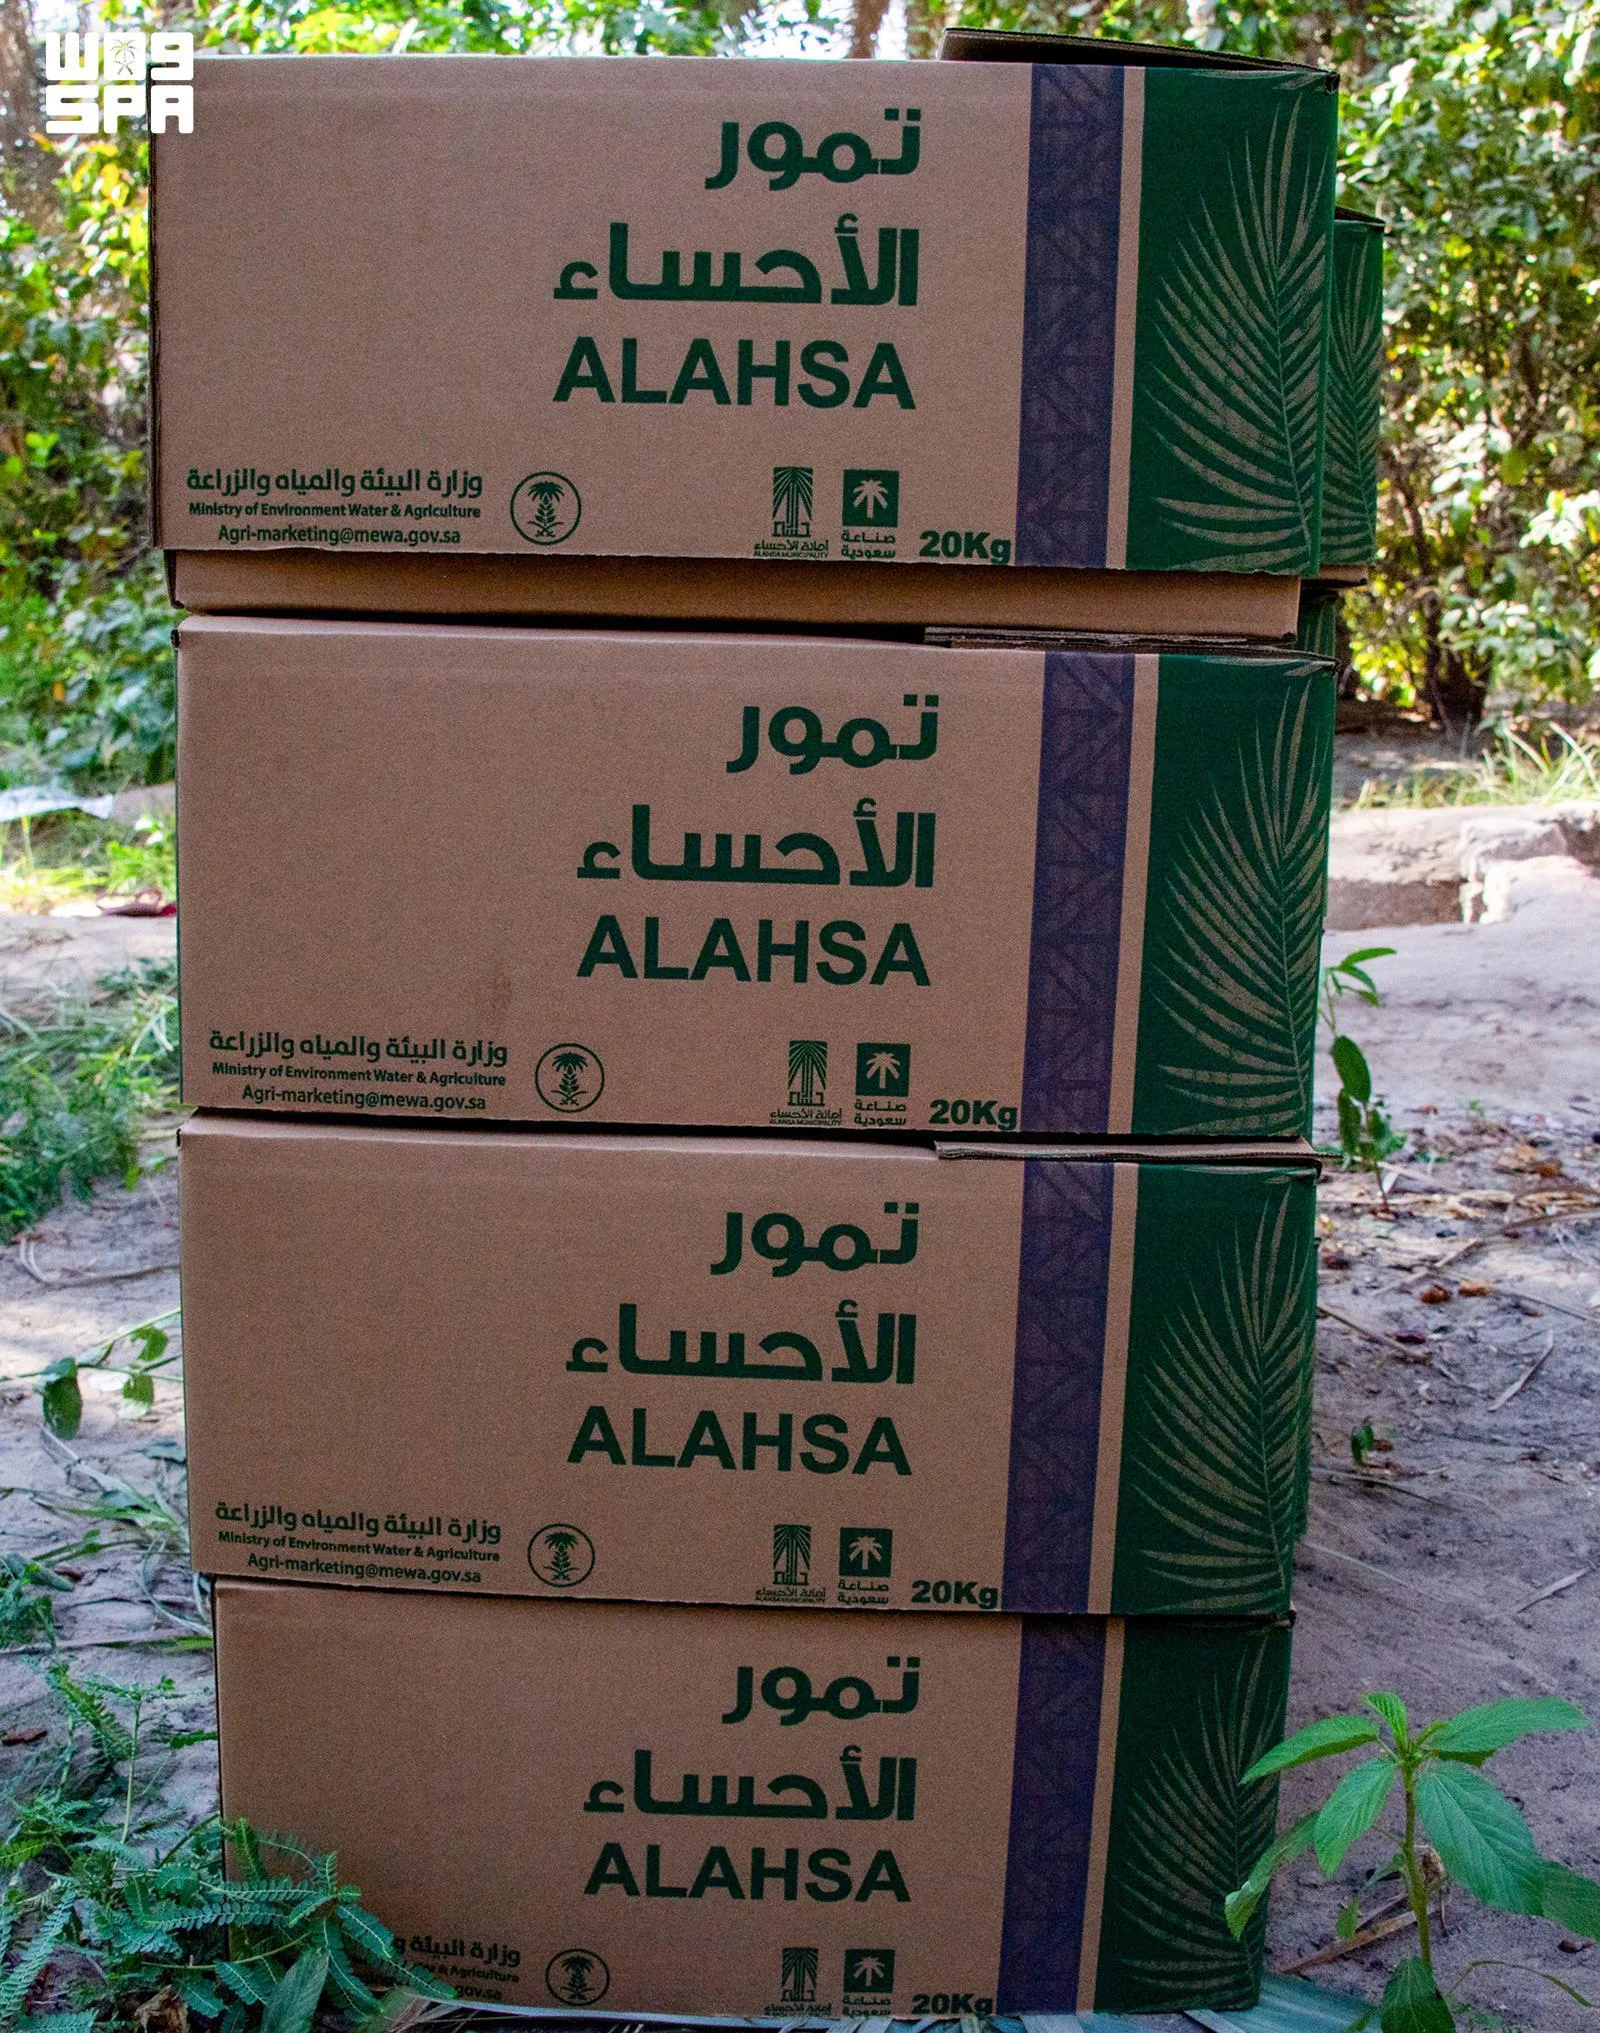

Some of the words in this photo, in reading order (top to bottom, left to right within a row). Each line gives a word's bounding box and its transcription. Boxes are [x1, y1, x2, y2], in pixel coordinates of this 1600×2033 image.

[704, 108, 921, 191] تمور
[553, 213, 920, 306] الأحساء
[552, 336, 916, 409] ALAHSA
[187, 468, 270, 498] والزراعة
[275, 468, 355, 498] والمياه
[360, 467, 421, 497] البيئة
[427, 469, 484, 499] وزارة
[189, 502, 242, 519] Ministry
[245, 502, 259, 515] of
[261, 503, 347, 516] Environment
[349, 503, 388, 517] Water
[391, 504, 401, 516] &
[404, 504, 481, 520] Agriculture
[218, 524, 461, 546] Agri-marketing@mewa.gov.sa
[841, 530, 896, 544] صناعة
[919, 530, 1011, 565] 20Kg
[841, 544, 896, 559] سعودية
[726, 694, 939, 775] تمور
[577, 797, 936, 888] الأحساء
[576, 914, 931, 986] ALAHSA
[209, 1030, 295, 1059] والزراعة
[300, 1034, 381, 1063] والمياه
[386, 1036, 446, 1063] البيئة
[452, 1039, 507, 1067] وزارة
[212, 1062, 266, 1079] Ministry
[269, 1065, 283, 1077] of
[286, 1066, 371, 1080] Environment
[373, 1069, 413, 1083] Water
[416, 1072, 427, 1083] &
[429, 1072, 506, 1087] Agriculture
[242, 1084, 486, 1112] Agri-marketing@mewa.gov.sa
[854, 1099, 906, 1112] صناعة
[854, 1114, 906, 1127] سعودية
[929, 1099, 1017, 1130] 20Kg
[710, 1202, 920, 1277] تمور
[566, 1299, 916, 1384] الأحساء
[567, 1405, 912, 1476] ALAHSA
[215, 1502, 297, 1531] والزراعة
[302, 1509, 379, 1537] والمياه
[384, 1513, 442, 1539] البيئة
[448, 1518, 501, 1544] وزارة
[219, 1531, 269, 1548] Ministry
[273, 1536, 286, 1546] of
[289, 1537, 371, 1554] Environment
[373, 1543, 411, 1556] Water
[414, 1546, 424, 1557] &
[426, 1547, 500, 1561] Agriculture
[248, 1553, 481, 1584] Agri-marketing@mewa.gov.sa
[838, 1579, 889, 1592] صناعة
[838, 1593, 889, 1606] سعودية
[912, 1580, 998, 1610] 20Kg
[722, 1656, 920, 1726] تمور
[583, 1745, 917, 1821] الأحساء
[583, 1842, 911, 1903] ALAHSA
[469, 1945, 520, 1968] وزارة
[450, 1966, 520, 1983] Agriculture
[912, 1993, 993, 2017] 20Kg
